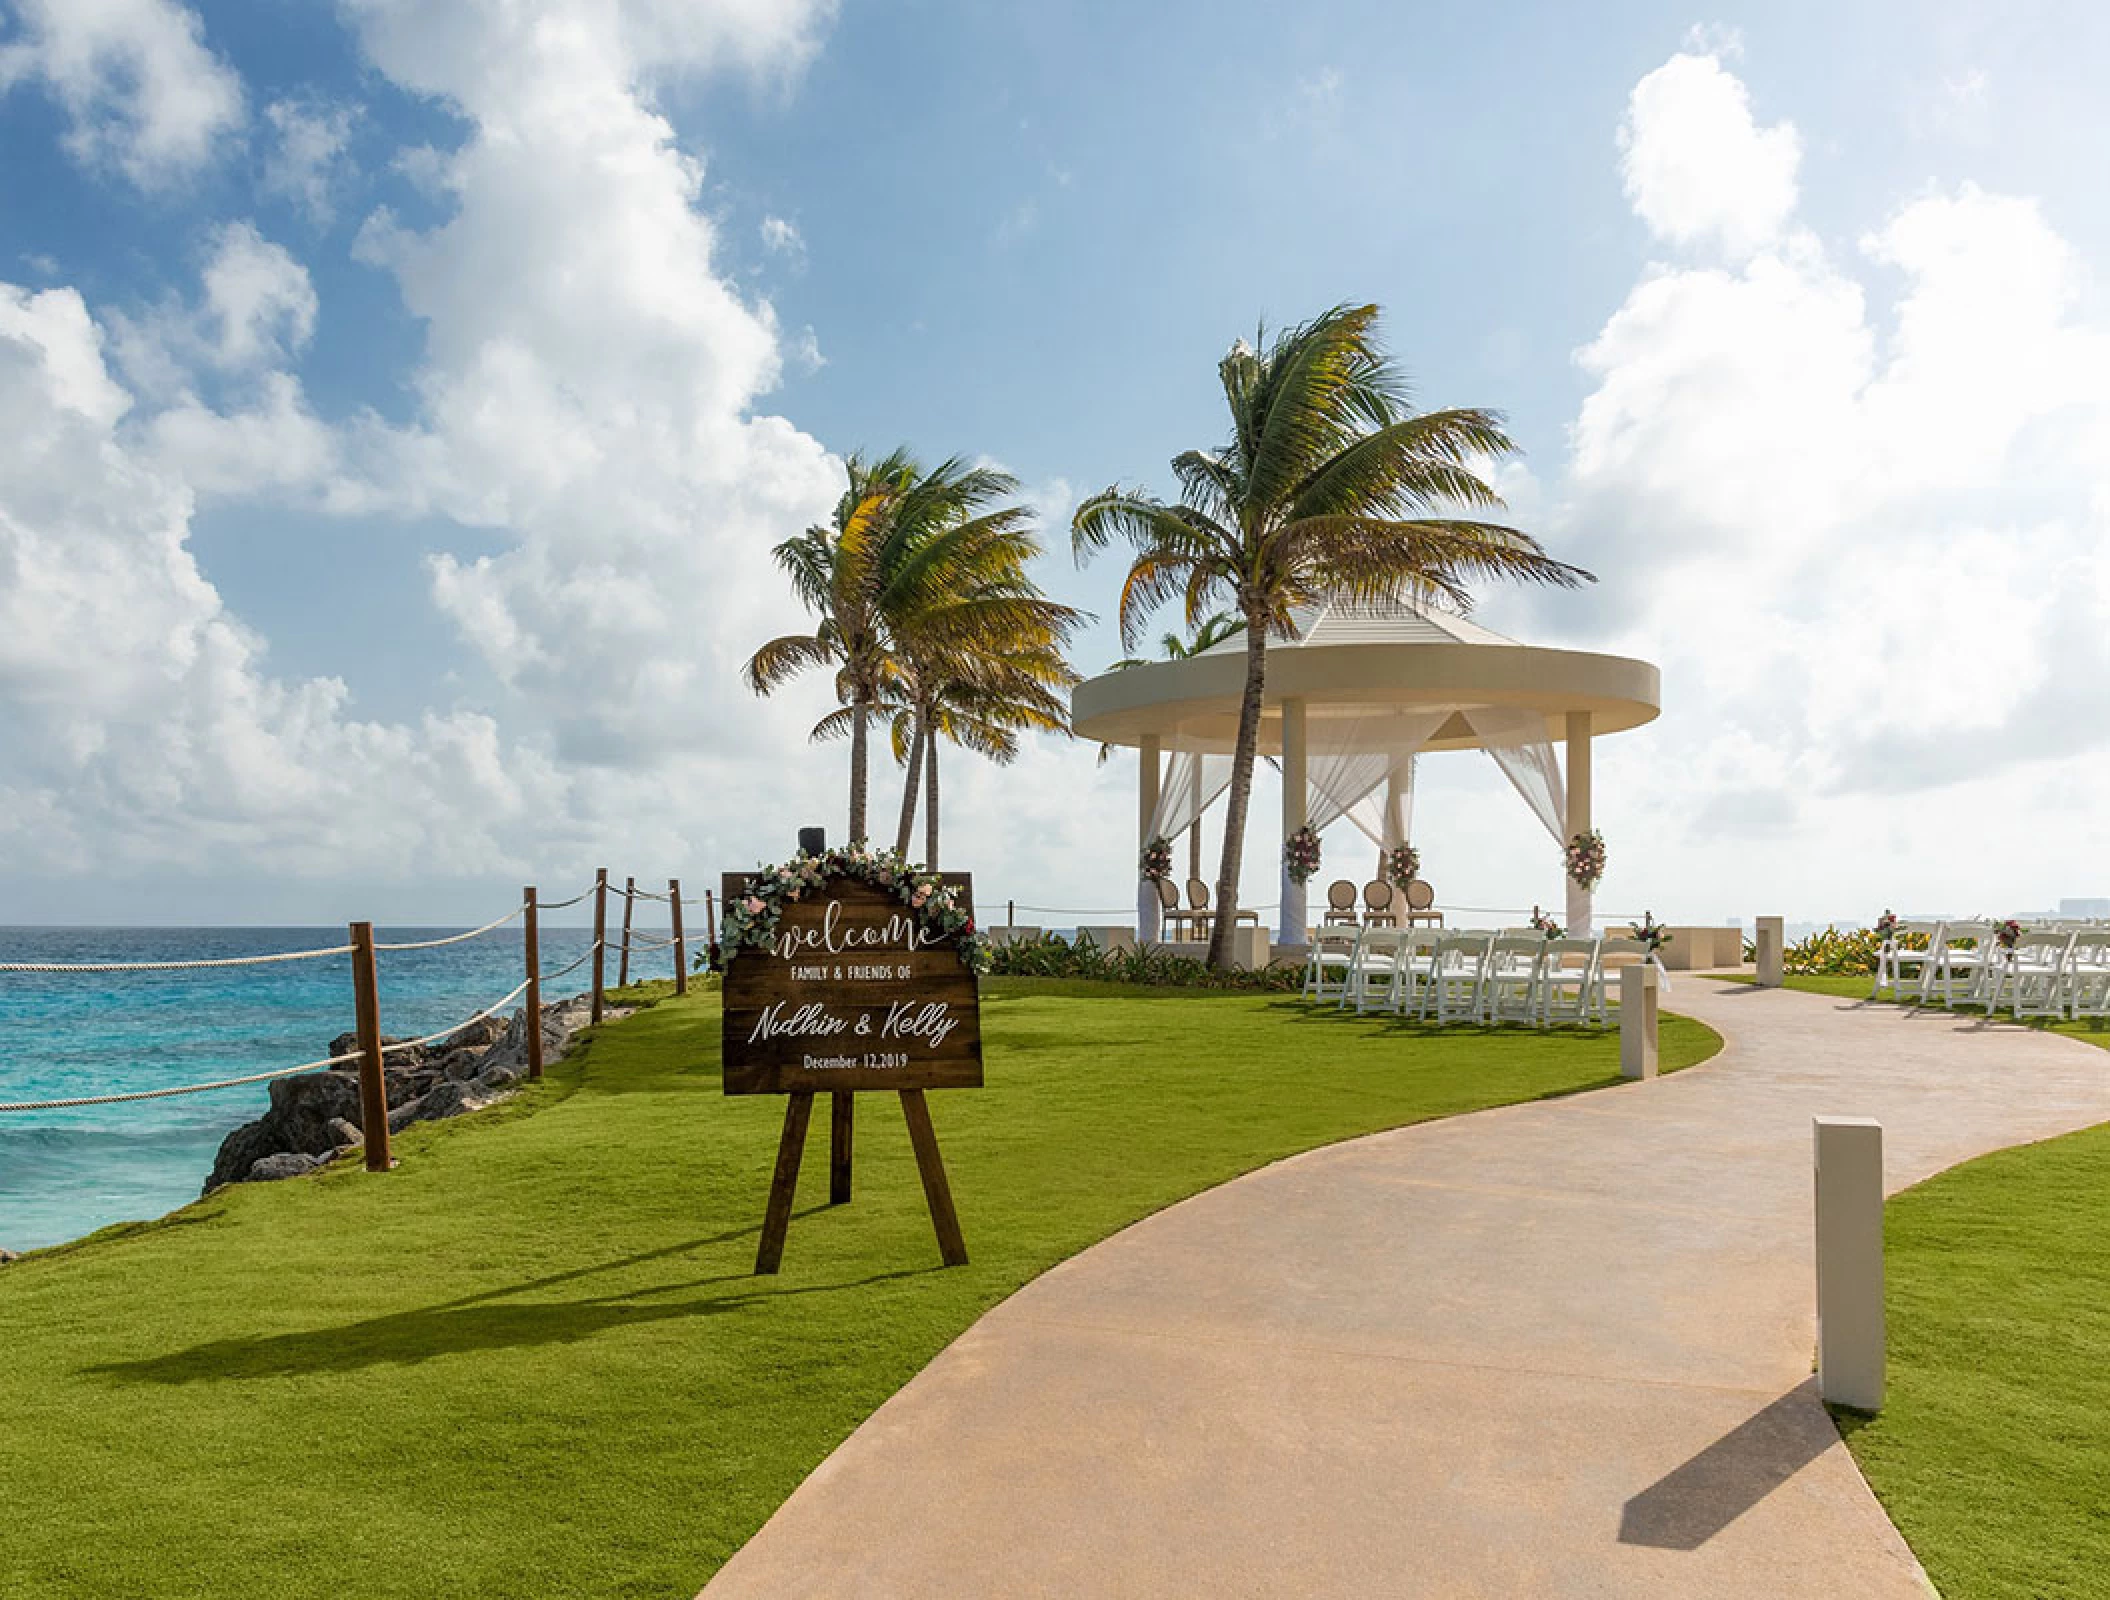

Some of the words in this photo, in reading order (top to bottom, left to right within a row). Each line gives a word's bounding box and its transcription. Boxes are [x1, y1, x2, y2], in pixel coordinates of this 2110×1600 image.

[790, 965, 828, 980] FAMILY
[834, 965, 843, 980] &
[848, 965, 892, 980] FRIENDS
[898, 965, 911, 980] OF
[854, 1013, 872, 1036] &
[881, 1000, 960, 1049] Kelly
[803, 1053, 857, 1069] December
